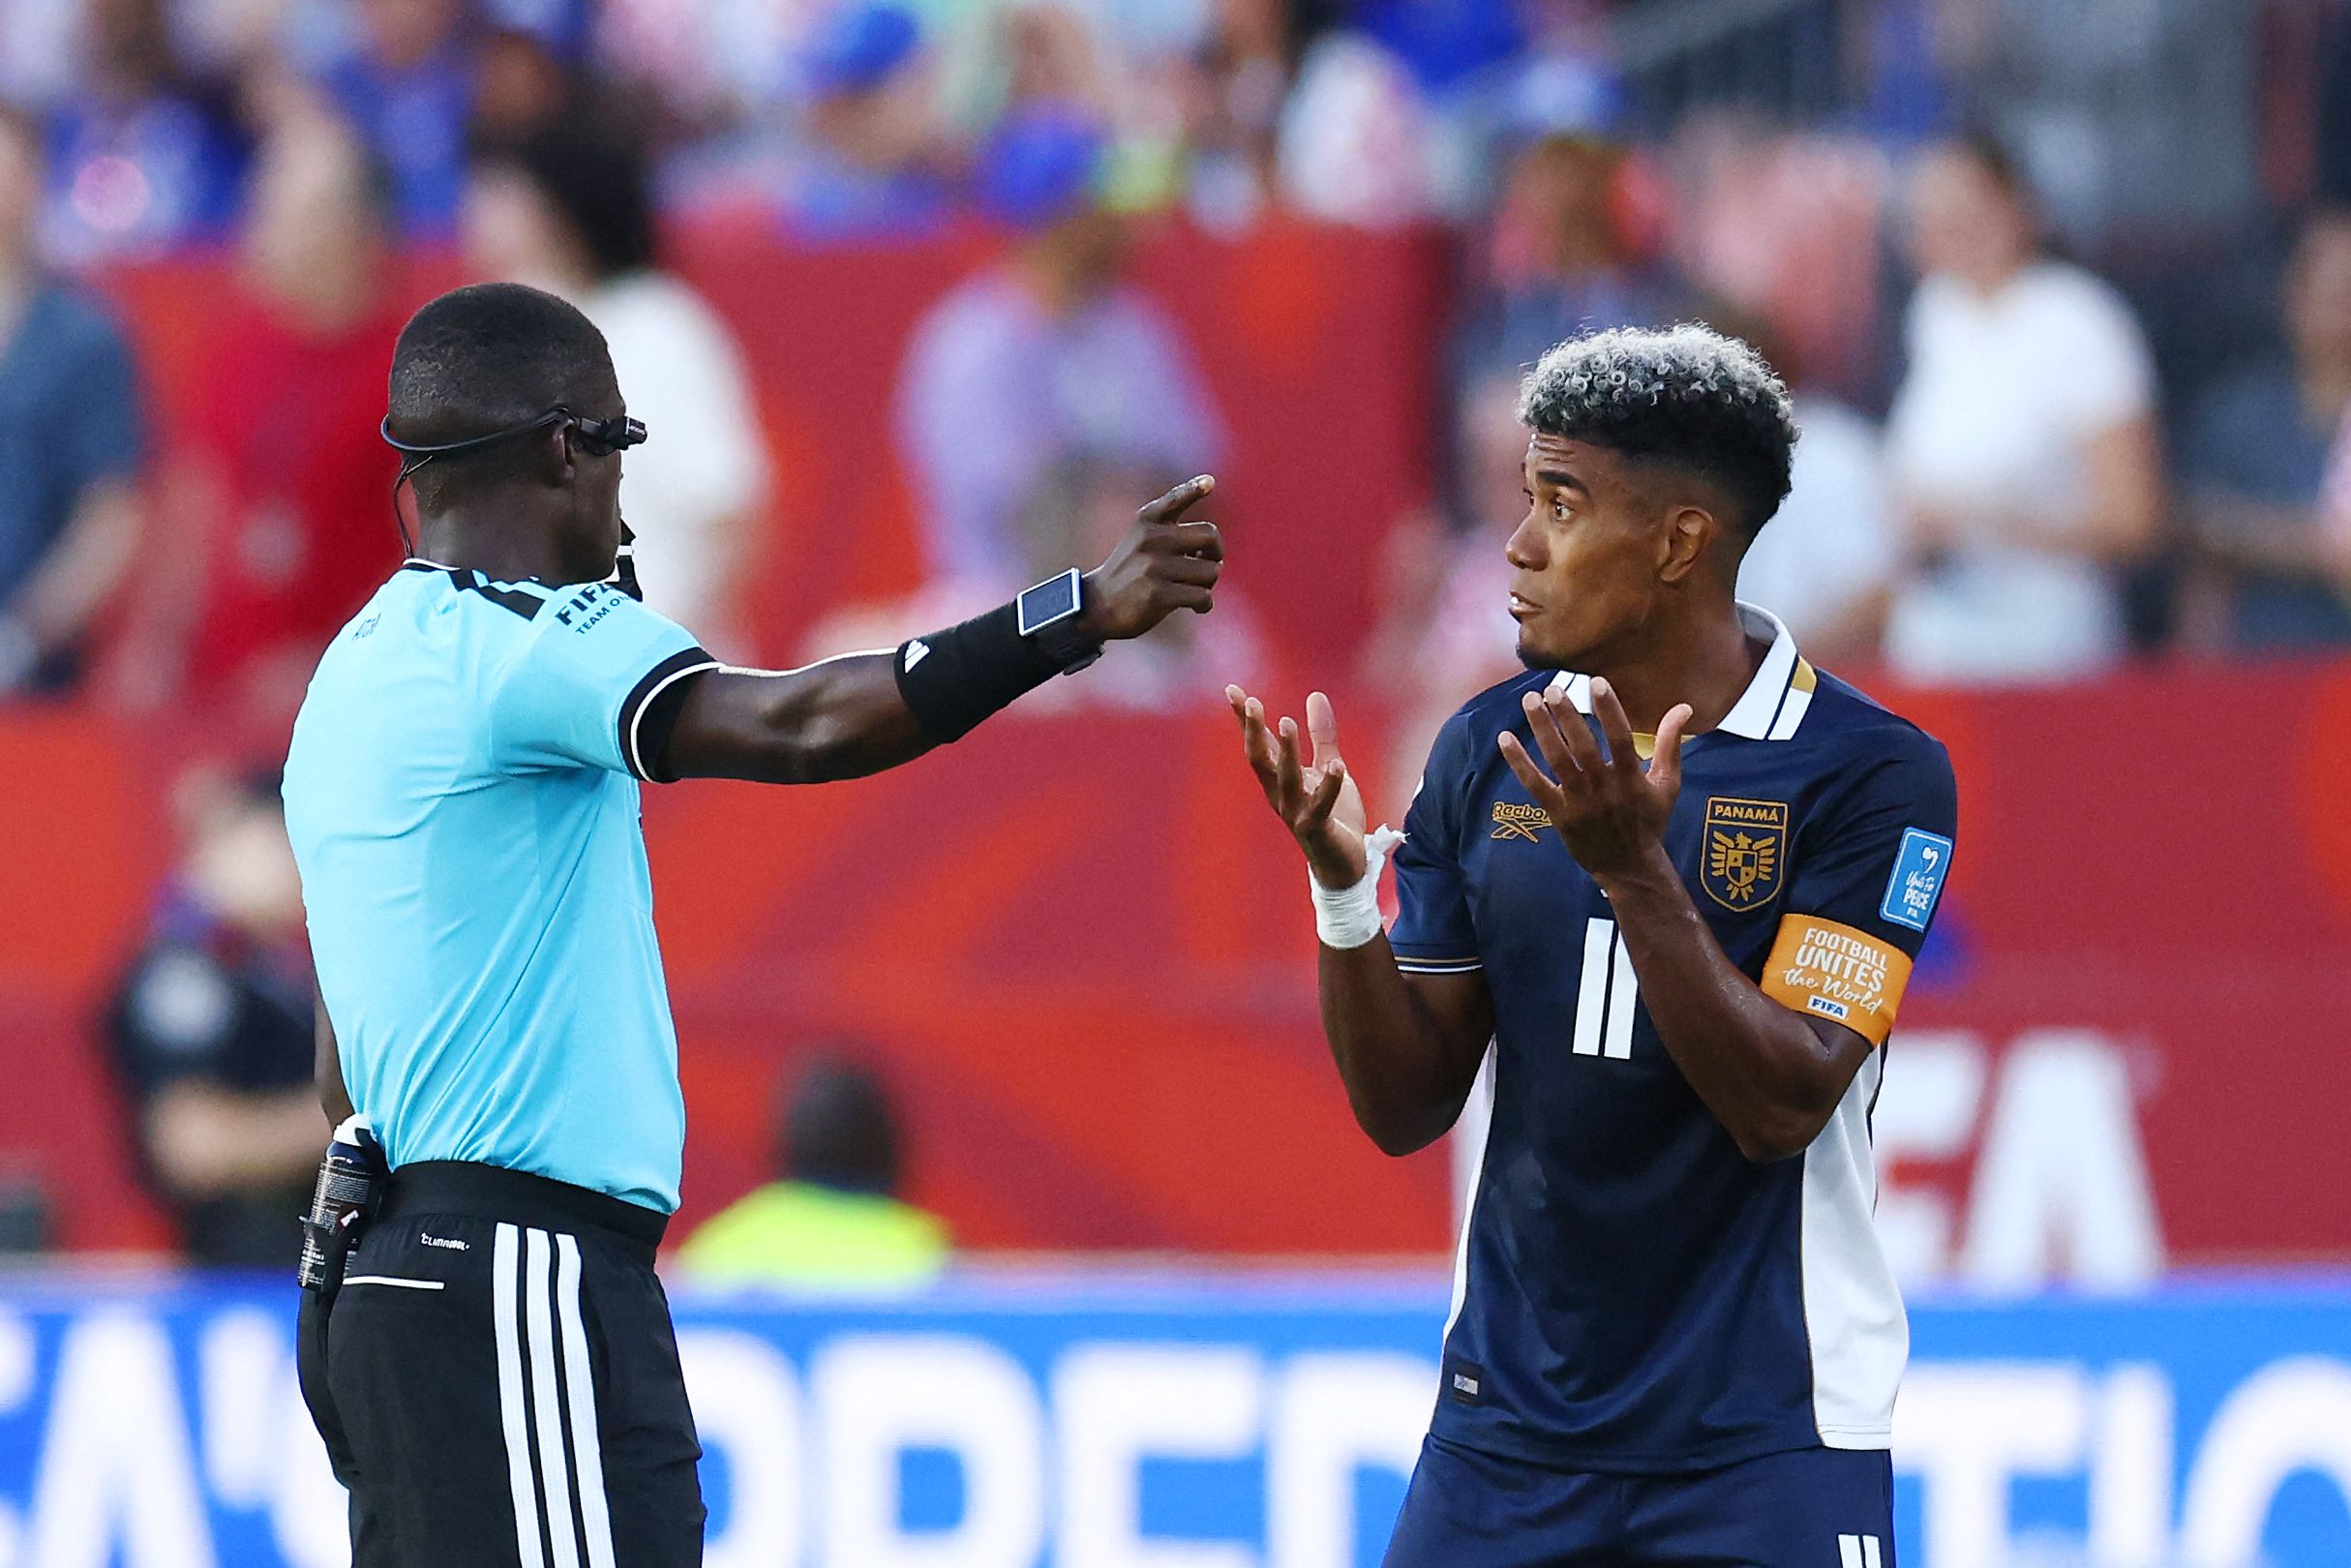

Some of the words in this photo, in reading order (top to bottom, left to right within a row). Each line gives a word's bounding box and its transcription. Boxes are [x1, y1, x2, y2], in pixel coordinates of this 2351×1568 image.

[575, 607, 611, 634] TEAM
[1492, 801, 1551, 822] Reebo
[1715, 804, 1778, 822] PANAMÁ
[1803, 927, 1887, 972] FOOTBALL
[1794, 944, 1885, 992] UNITES
[1572, 918, 1638, 1059] 11
[1783, 968, 1819, 988] the
[1822, 975, 1884, 1015] World
[1811, 998, 1844, 1016] FIFA
